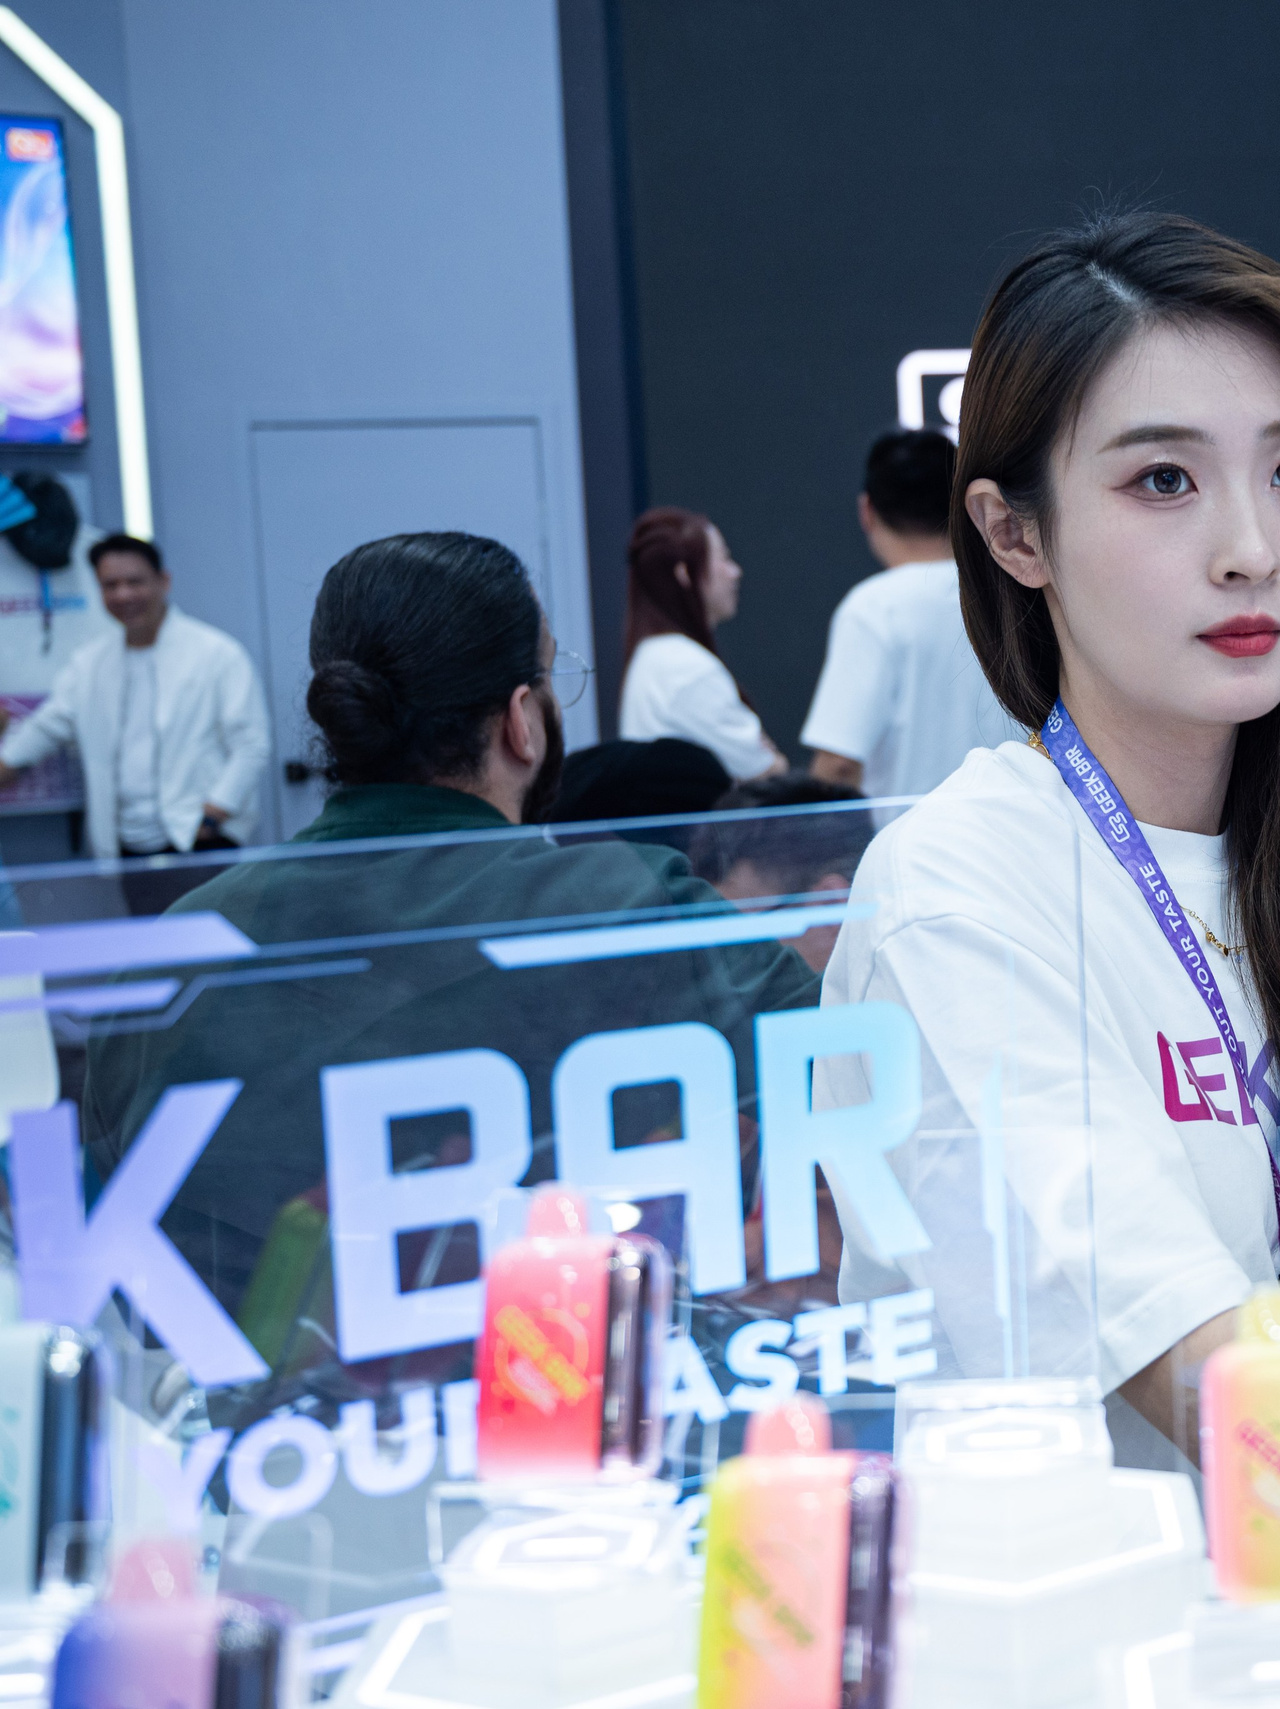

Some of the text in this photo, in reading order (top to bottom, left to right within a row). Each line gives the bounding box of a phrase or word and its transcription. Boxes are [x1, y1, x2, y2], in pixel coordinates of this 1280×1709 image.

[1065, 744, 1092, 777] BAR
[1082, 771, 1117, 814] GEEK
[1139, 861, 1237, 1053] OUT YOUR TASTE
[320, 1000, 934, 1364] BAR
[648, 1287, 938, 1424] ASTE
